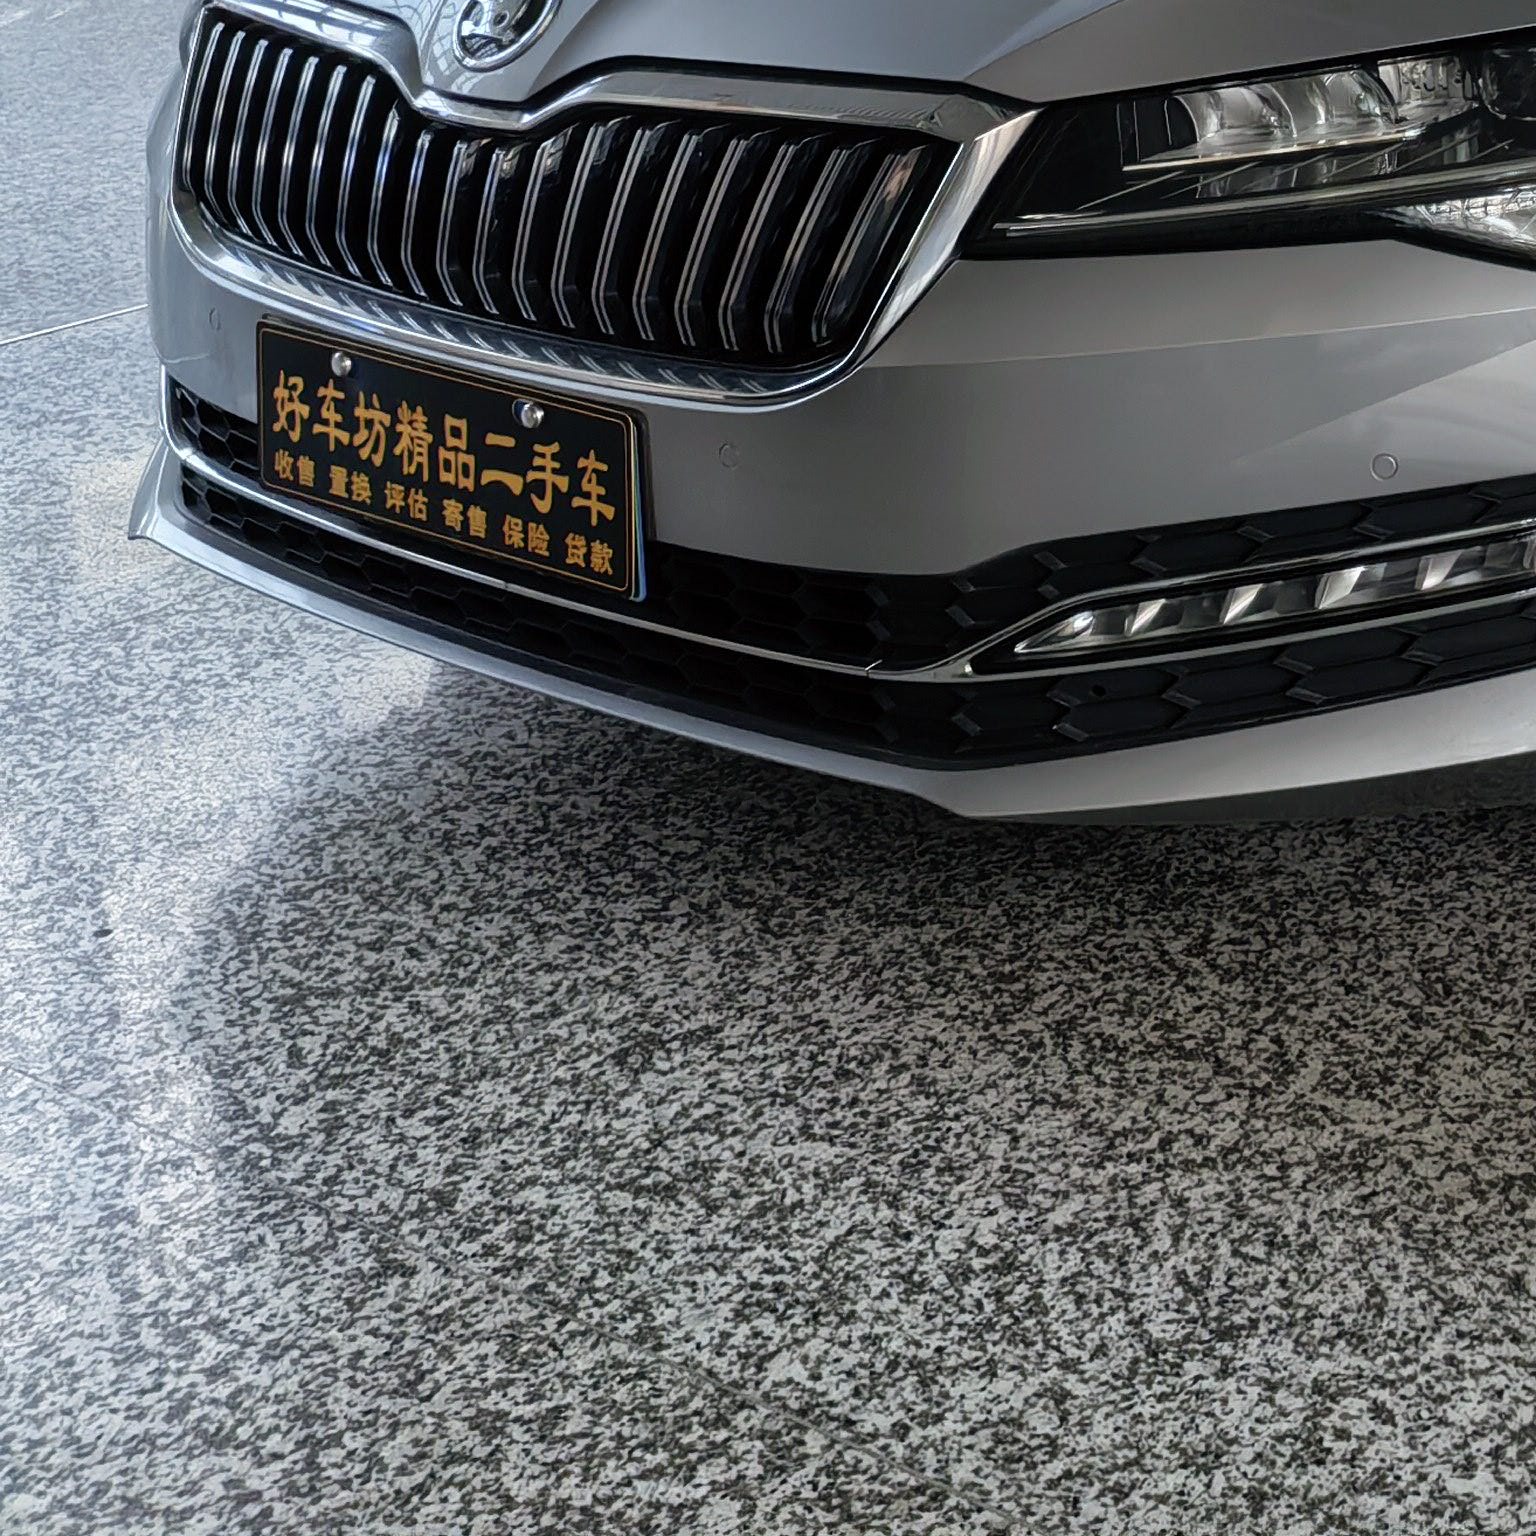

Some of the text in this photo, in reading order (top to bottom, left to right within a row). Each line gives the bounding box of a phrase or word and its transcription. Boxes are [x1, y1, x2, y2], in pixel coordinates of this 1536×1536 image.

[272, 369, 615, 526] 好车坊精品二手车
[273, 448, 614, 576] 收售 置换 评估 寄售 保险 贷款
